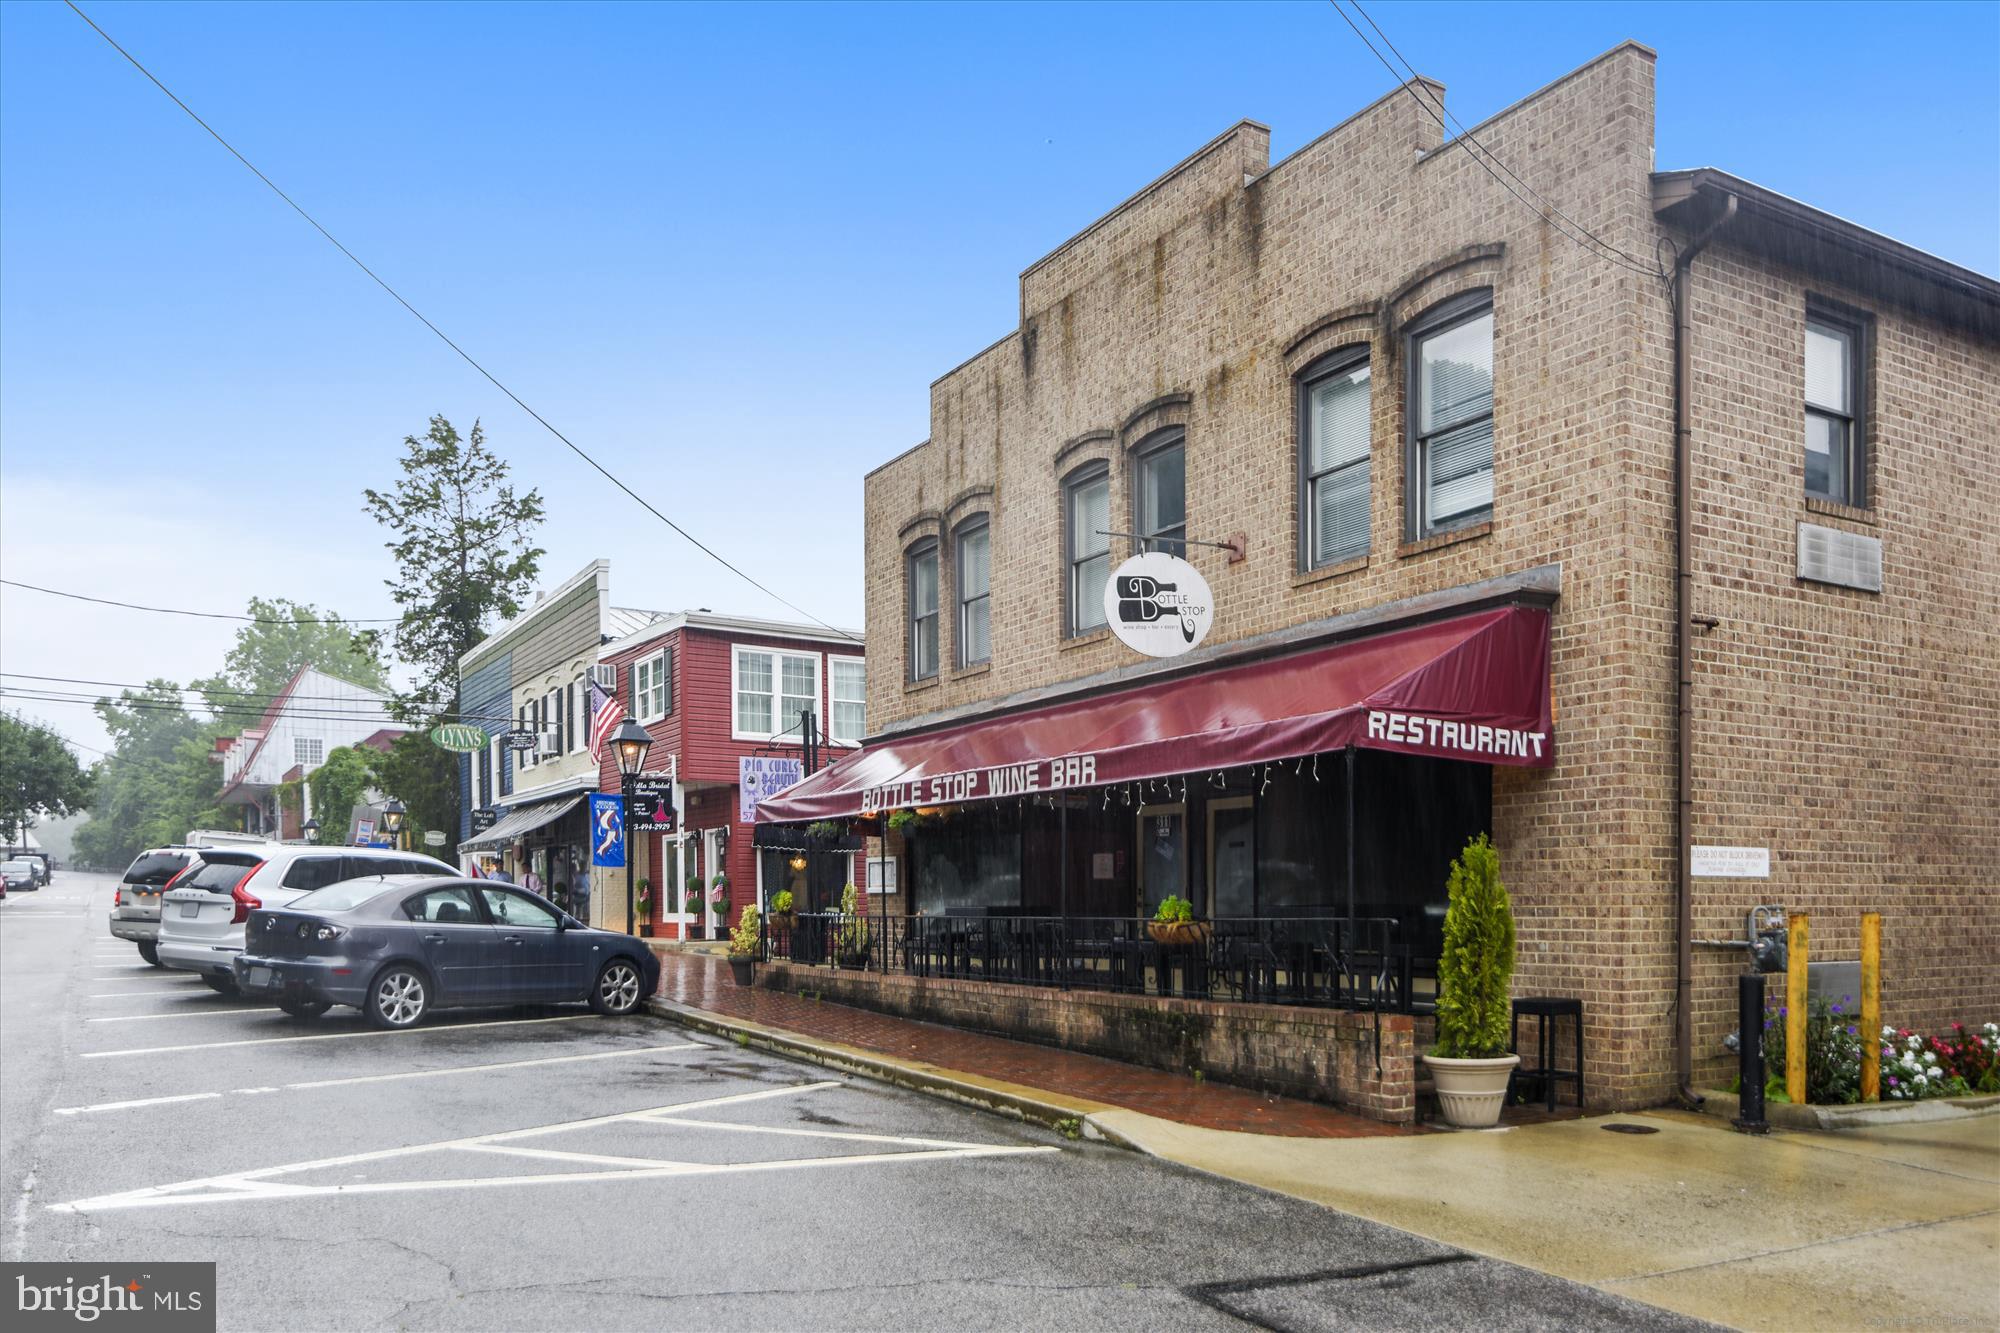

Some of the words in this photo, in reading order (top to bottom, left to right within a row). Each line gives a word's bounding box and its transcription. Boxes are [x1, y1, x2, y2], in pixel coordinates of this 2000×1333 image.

[1182, 606, 1206, 616] STOP
[1368, 710, 1546, 758] RESTAURANT
[769, 760, 799, 773] CURLS
[648, 780, 670, 789] Bridal
[861, 782, 922, 812] BOTTLE
[930, 772, 978, 803] STOP
[988, 763, 1040, 797] WINE
[1050, 755, 1097, 788] BAR
